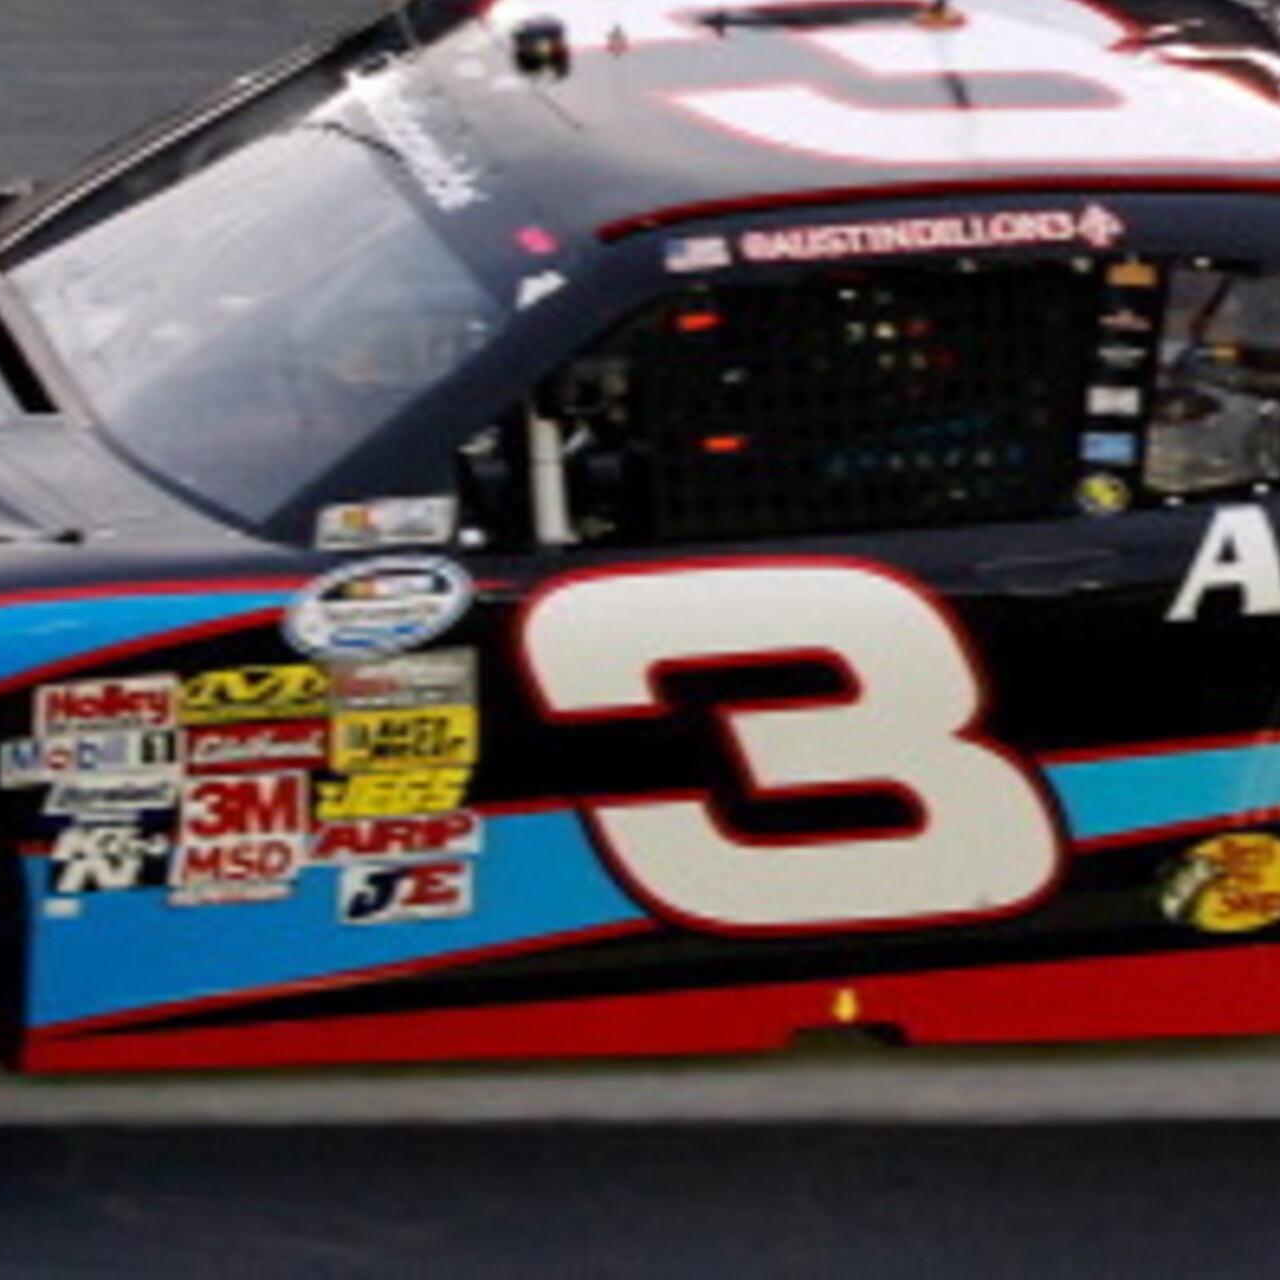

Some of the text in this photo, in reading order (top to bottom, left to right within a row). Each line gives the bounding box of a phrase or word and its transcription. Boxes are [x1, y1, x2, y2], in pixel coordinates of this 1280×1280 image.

[46, 684, 173, 727] Holley
[522, 556, 1067, 935] 3
[188, 776, 302, 838] 3M
[316, 812, 478, 859] ARP
[183, 839, 295, 885] MSD
[348, 862, 468, 919] JE
